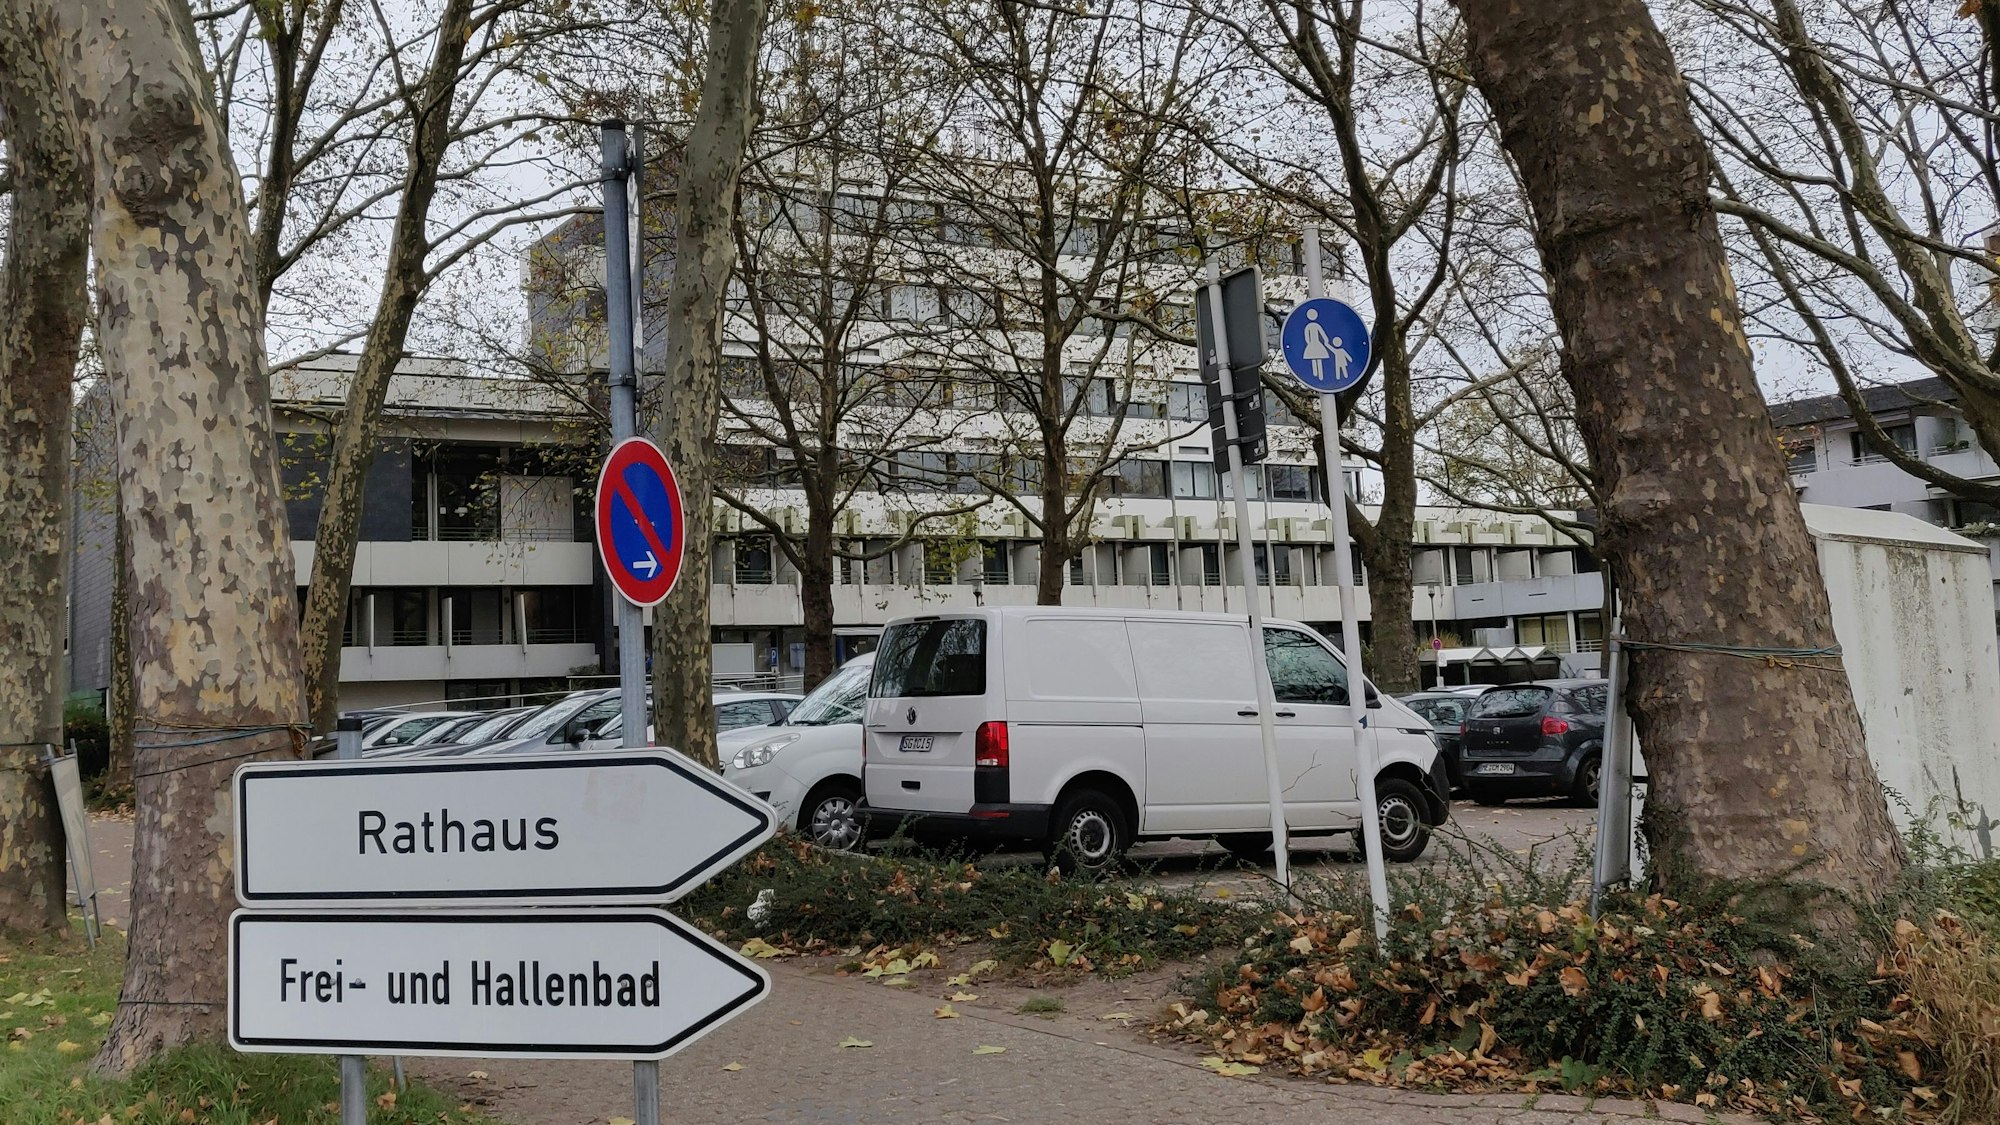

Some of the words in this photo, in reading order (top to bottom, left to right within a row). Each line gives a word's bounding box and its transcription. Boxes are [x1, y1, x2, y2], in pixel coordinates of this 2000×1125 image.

[359, 809, 559, 855] Rathaus
[281, 959, 366, 1003] Frei-
[388, 960, 450, 1005] und
[472, 960, 660, 1007] Hallenbad
